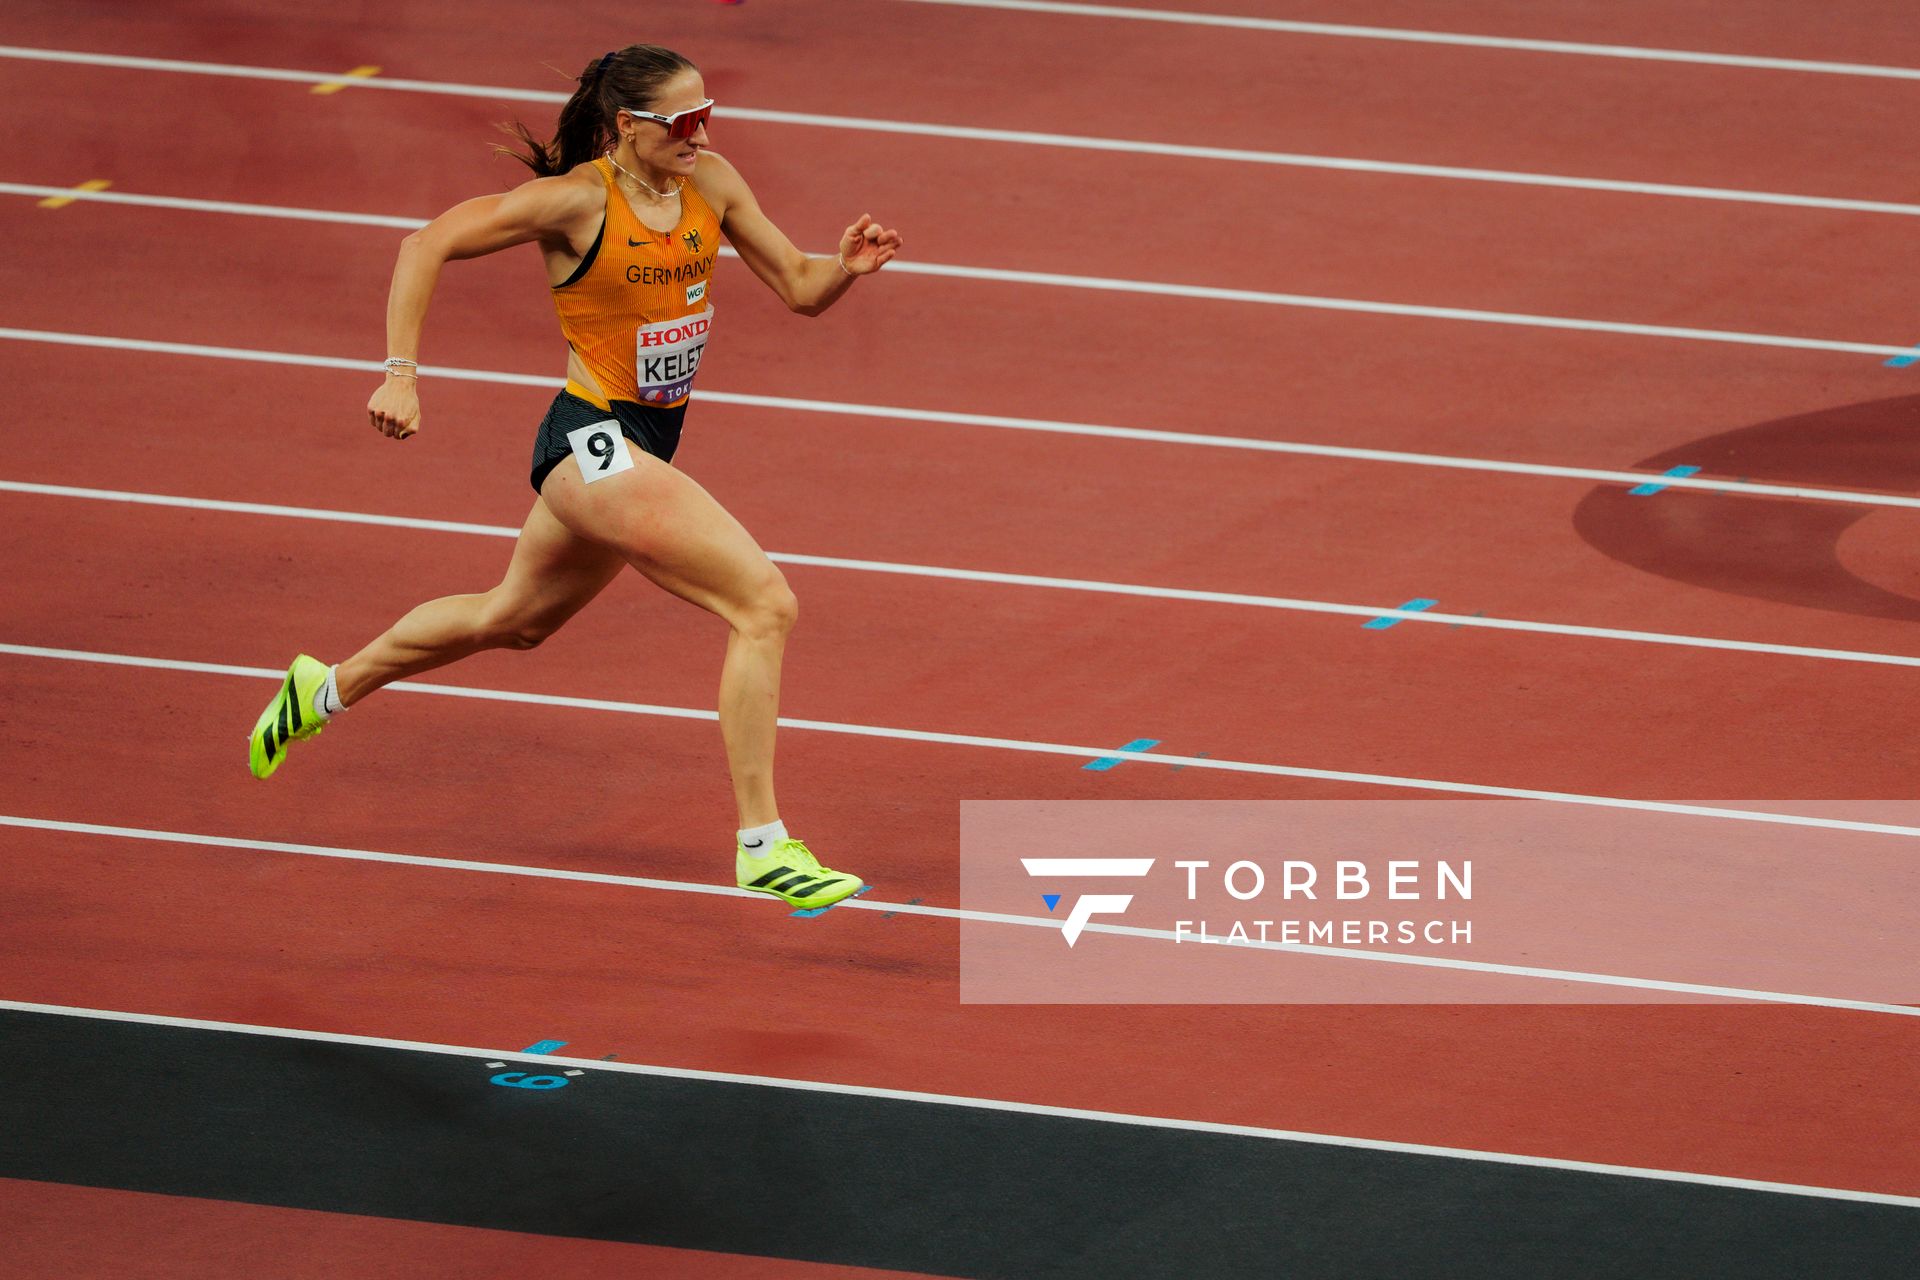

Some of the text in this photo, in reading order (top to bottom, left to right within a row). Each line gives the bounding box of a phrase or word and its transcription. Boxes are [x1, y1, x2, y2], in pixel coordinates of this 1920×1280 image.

[626, 253, 714, 285] GERMANY
[640, 319, 710, 348] HOND
[587, 431, 615, 470] 9
